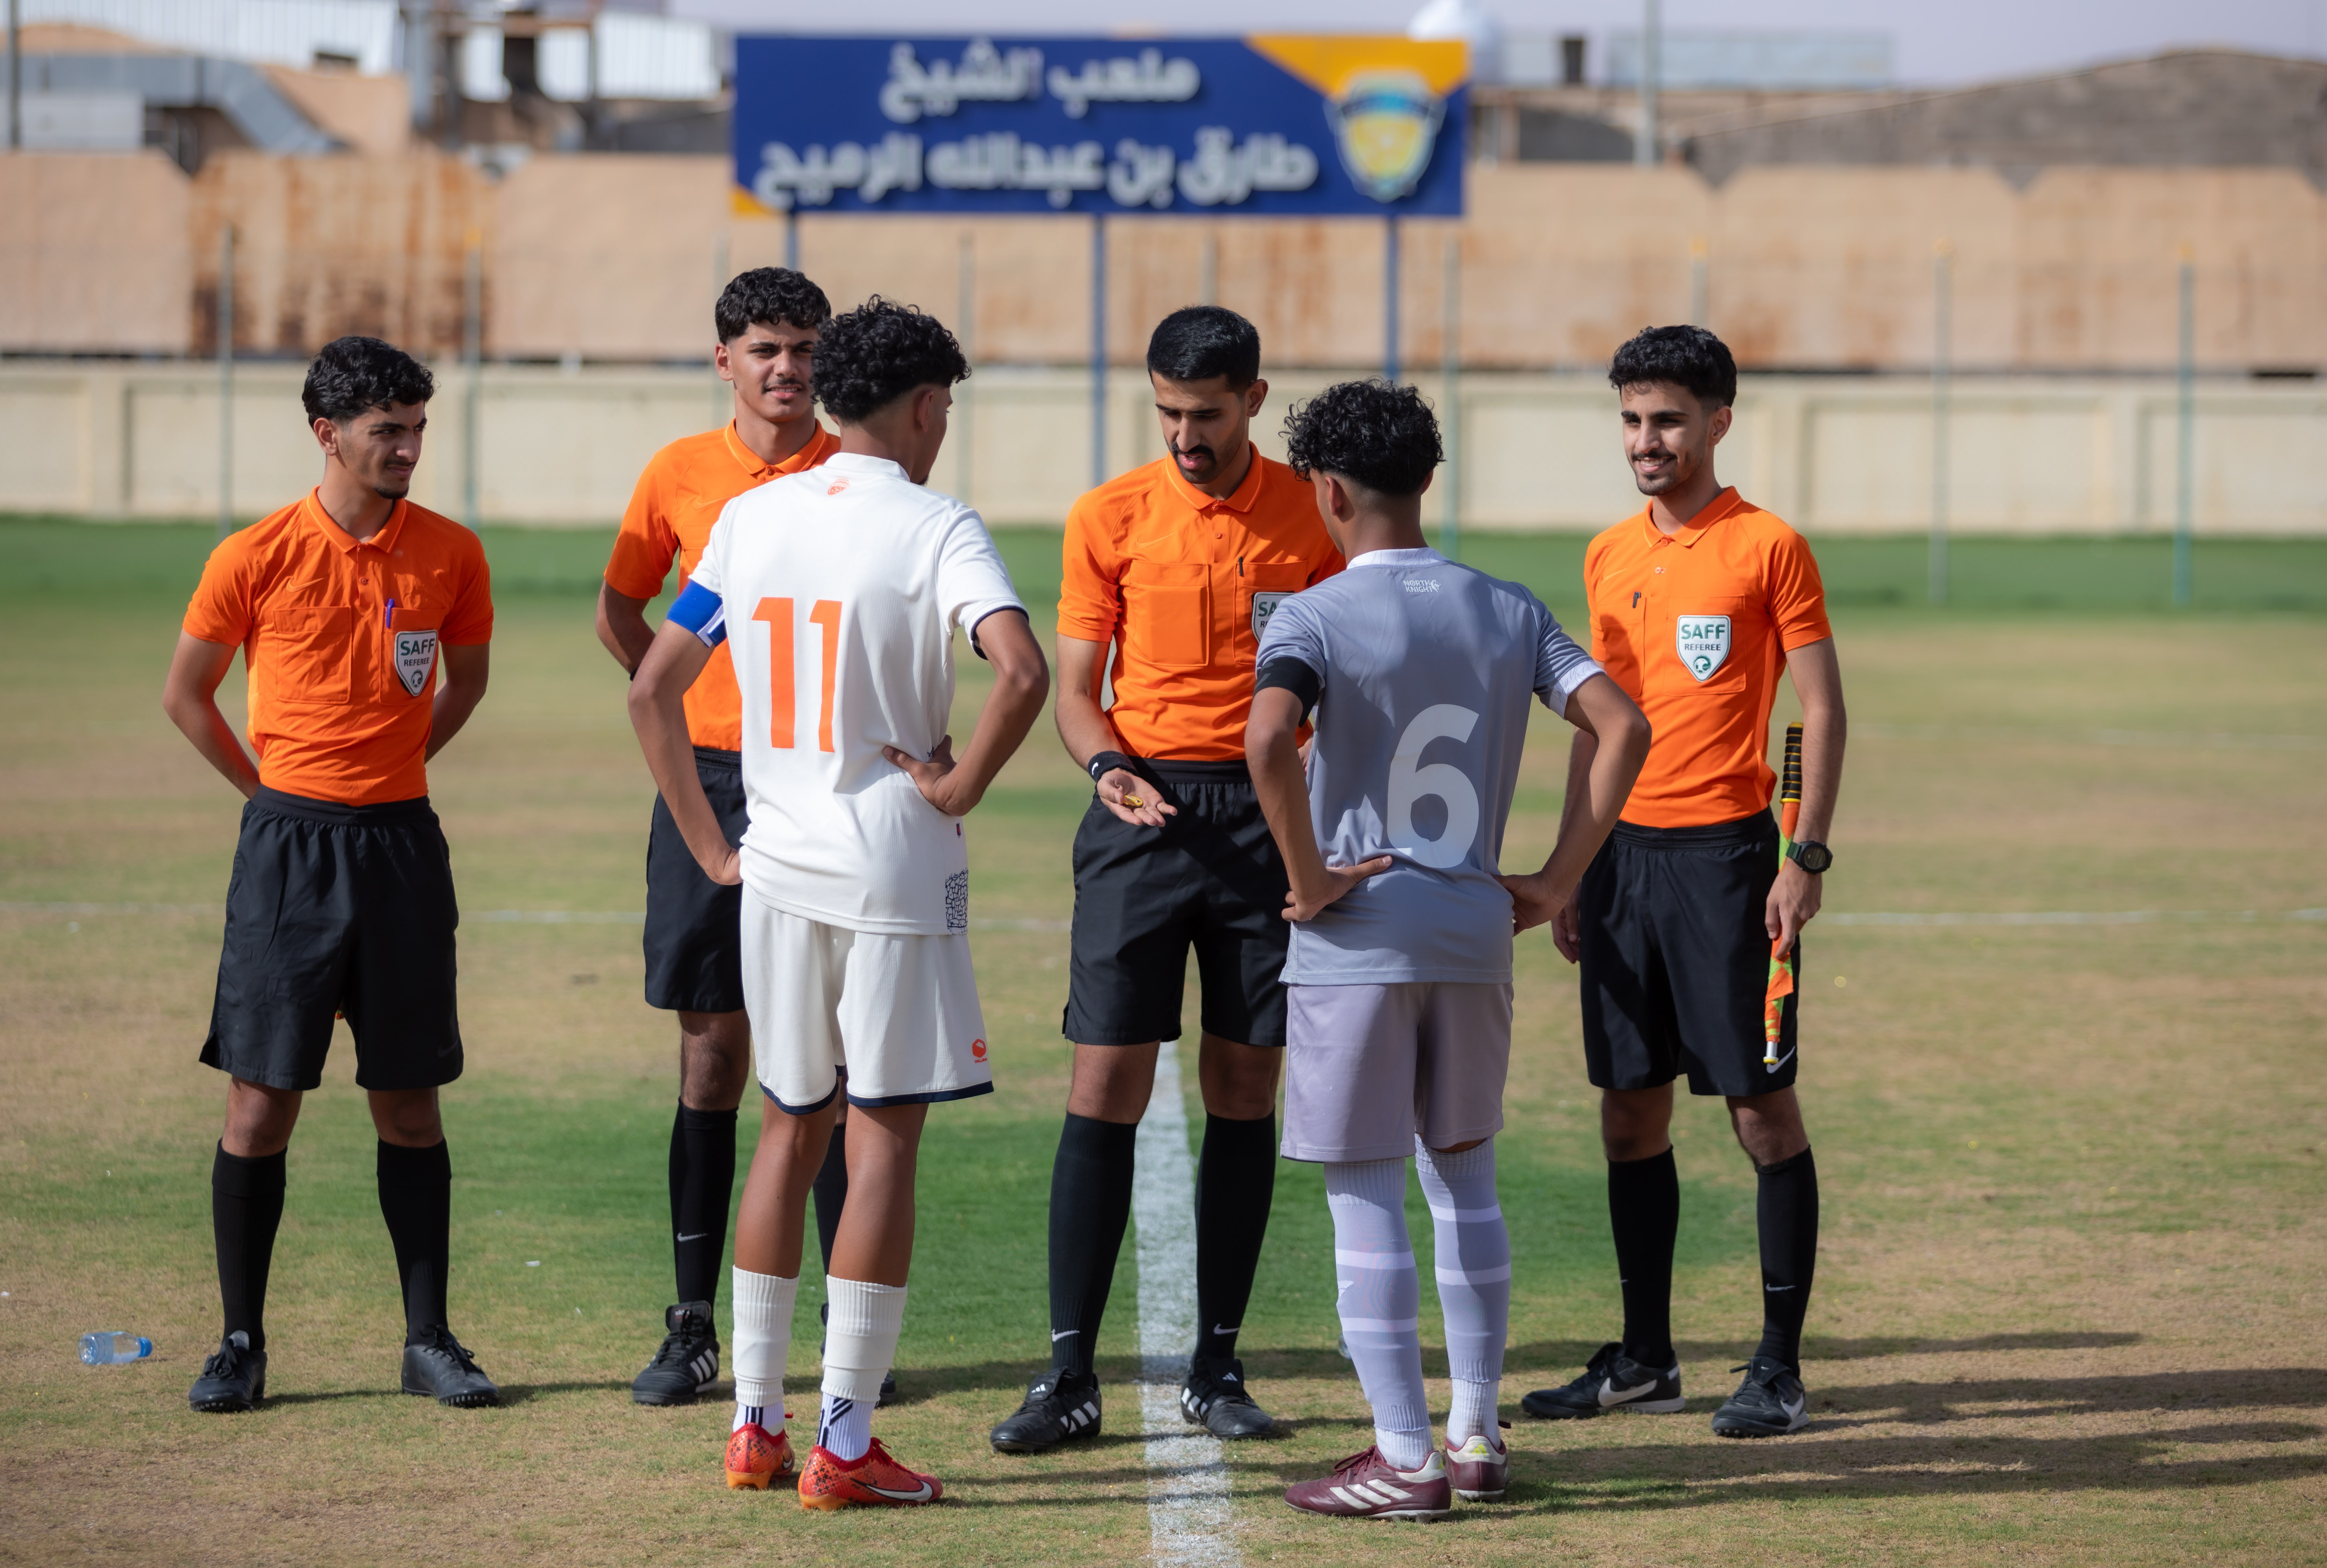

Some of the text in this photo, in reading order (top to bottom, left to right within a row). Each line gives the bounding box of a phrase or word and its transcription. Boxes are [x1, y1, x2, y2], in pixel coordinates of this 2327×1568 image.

[880, 37, 1200, 123] ملعب الشيخ
[752, 131, 922, 212] الرميح
[1106, 138, 1175, 209] بن
[1176, 125, 1319, 206] طارق
[400, 638, 435, 656] SAFF
[1258, 601, 1277, 617] SA
[1681, 624, 1725, 639] SAFF
[404, 657, 430, 666] REFEREE
[751, 597, 843, 752] 11
[1387, 704, 1479, 868] 6
